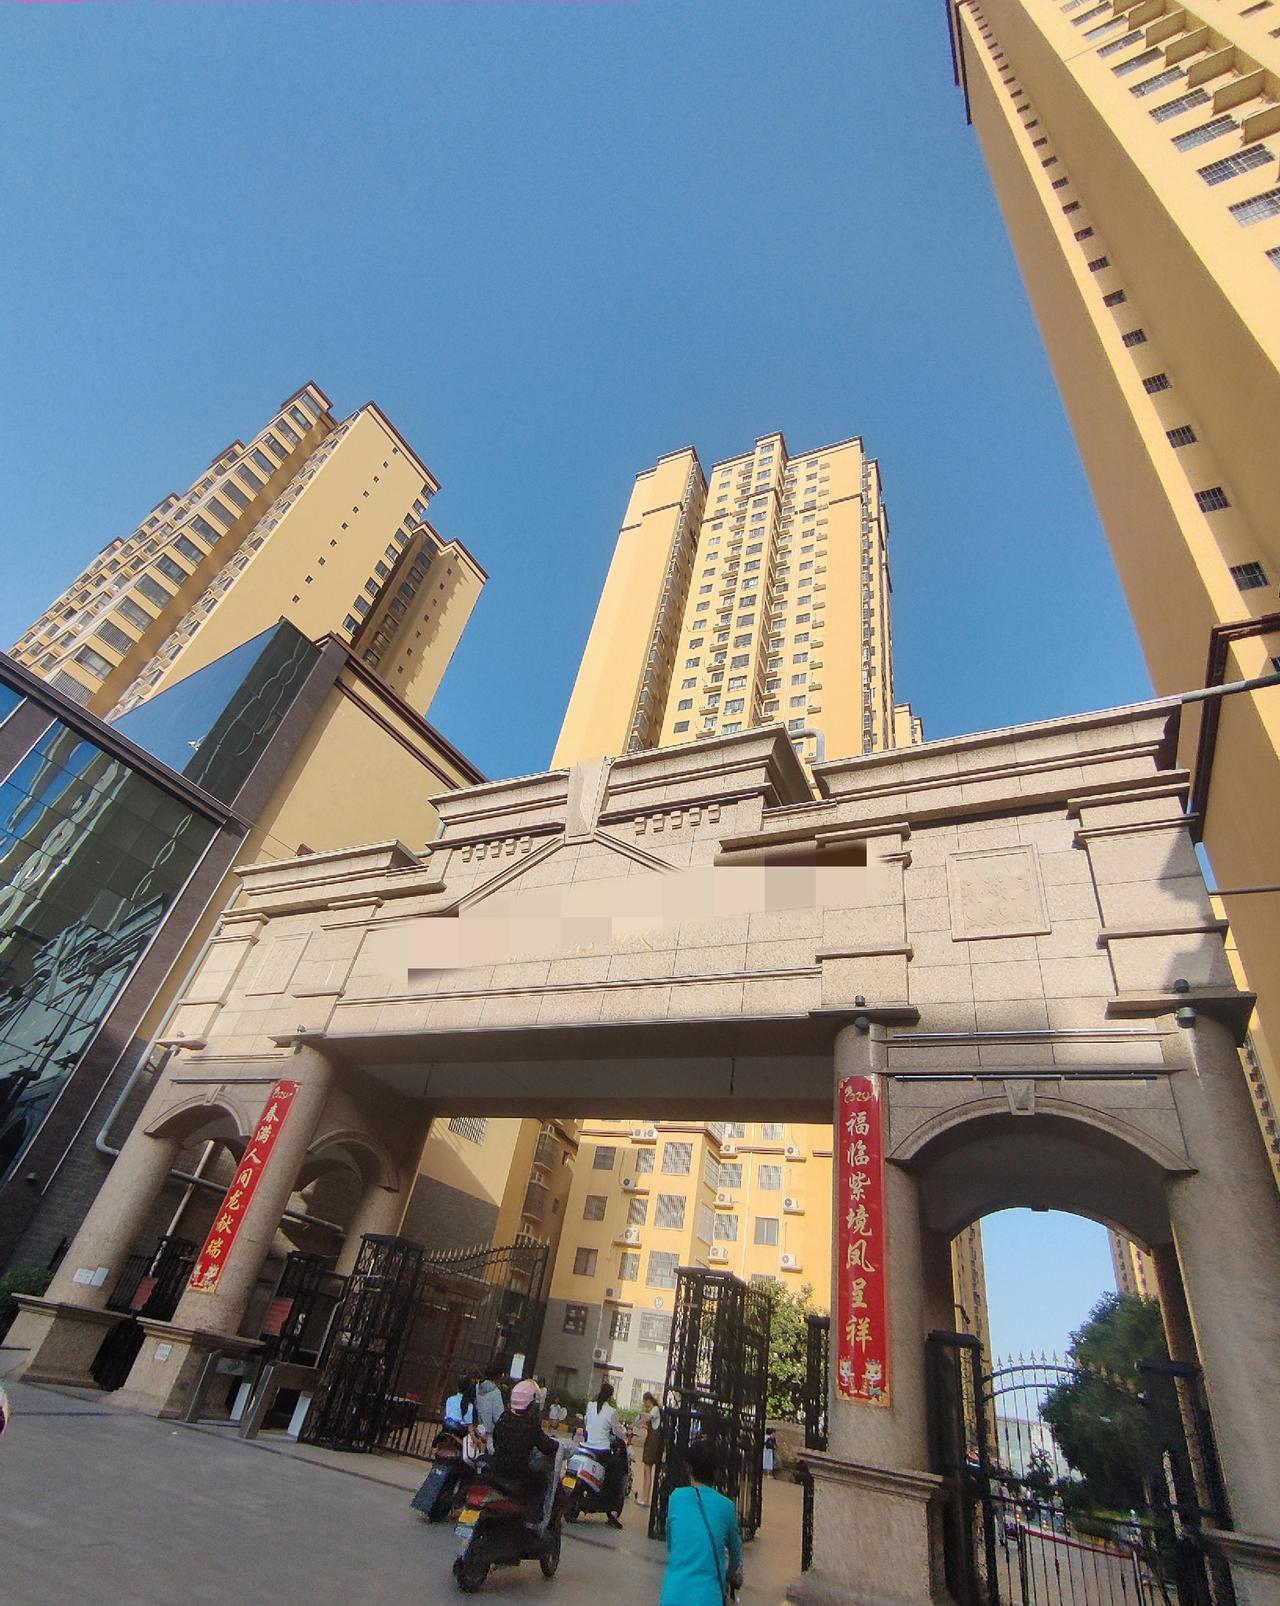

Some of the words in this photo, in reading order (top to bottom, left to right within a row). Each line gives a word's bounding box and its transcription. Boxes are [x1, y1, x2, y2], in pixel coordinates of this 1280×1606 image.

[845, 1111, 875, 1353] 福临紫境凤呈祥
